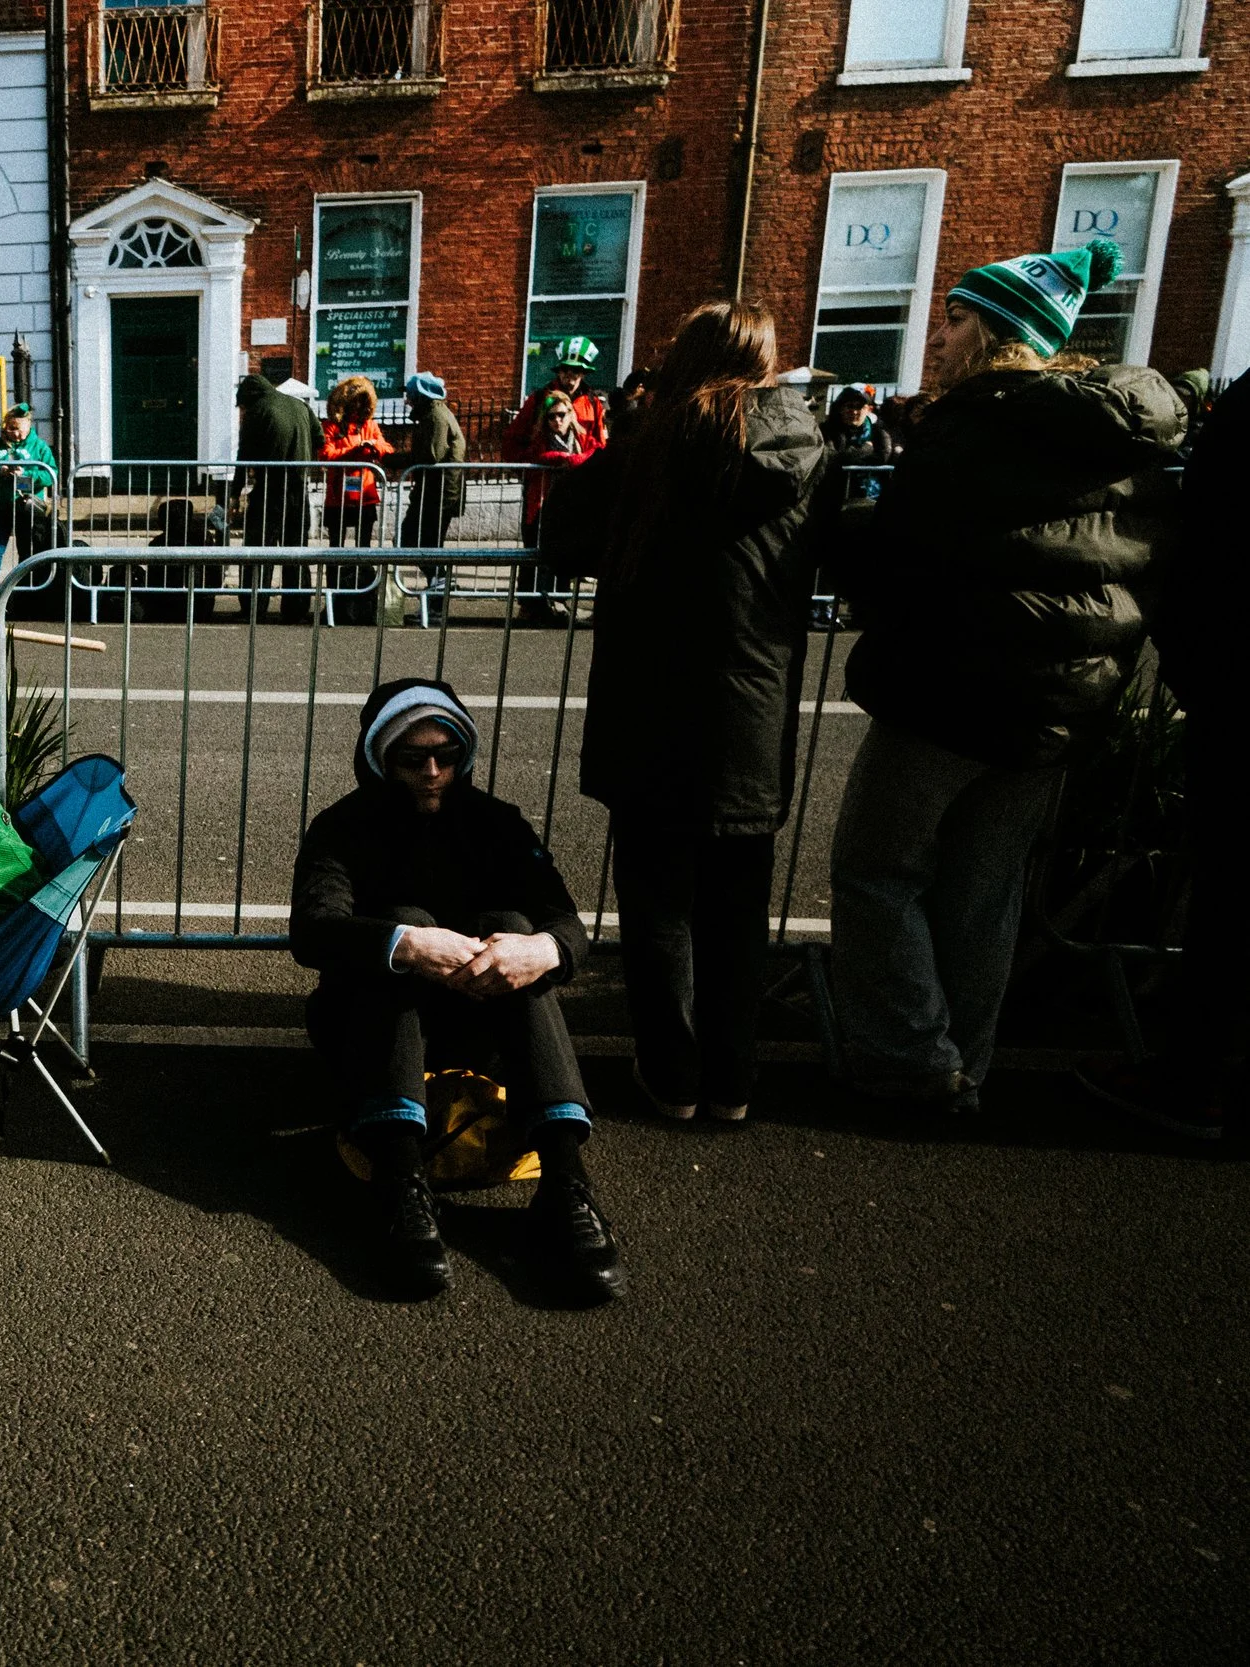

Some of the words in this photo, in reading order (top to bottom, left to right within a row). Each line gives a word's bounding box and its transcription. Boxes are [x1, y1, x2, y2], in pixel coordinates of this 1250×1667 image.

[1072, 208, 1119, 237] DQ
[844, 222, 891, 250] DQ
[324, 248, 367, 262] Beauty
[369, 246, 404, 258] Salon
[326, 310, 385, 321] SPECIALISTS
[388, 310, 399, 319] IN
[338, 321, 391, 331] Electrolysis
[337, 332, 354, 340] Red
[356, 332, 378, 340] Veins
[337, 341, 362, 349] White
[364, 341, 389, 349] Heads
[336, 350, 355, 358] Skin
[358, 350, 377, 358] Tags
[336, 359, 362, 367] Warts
